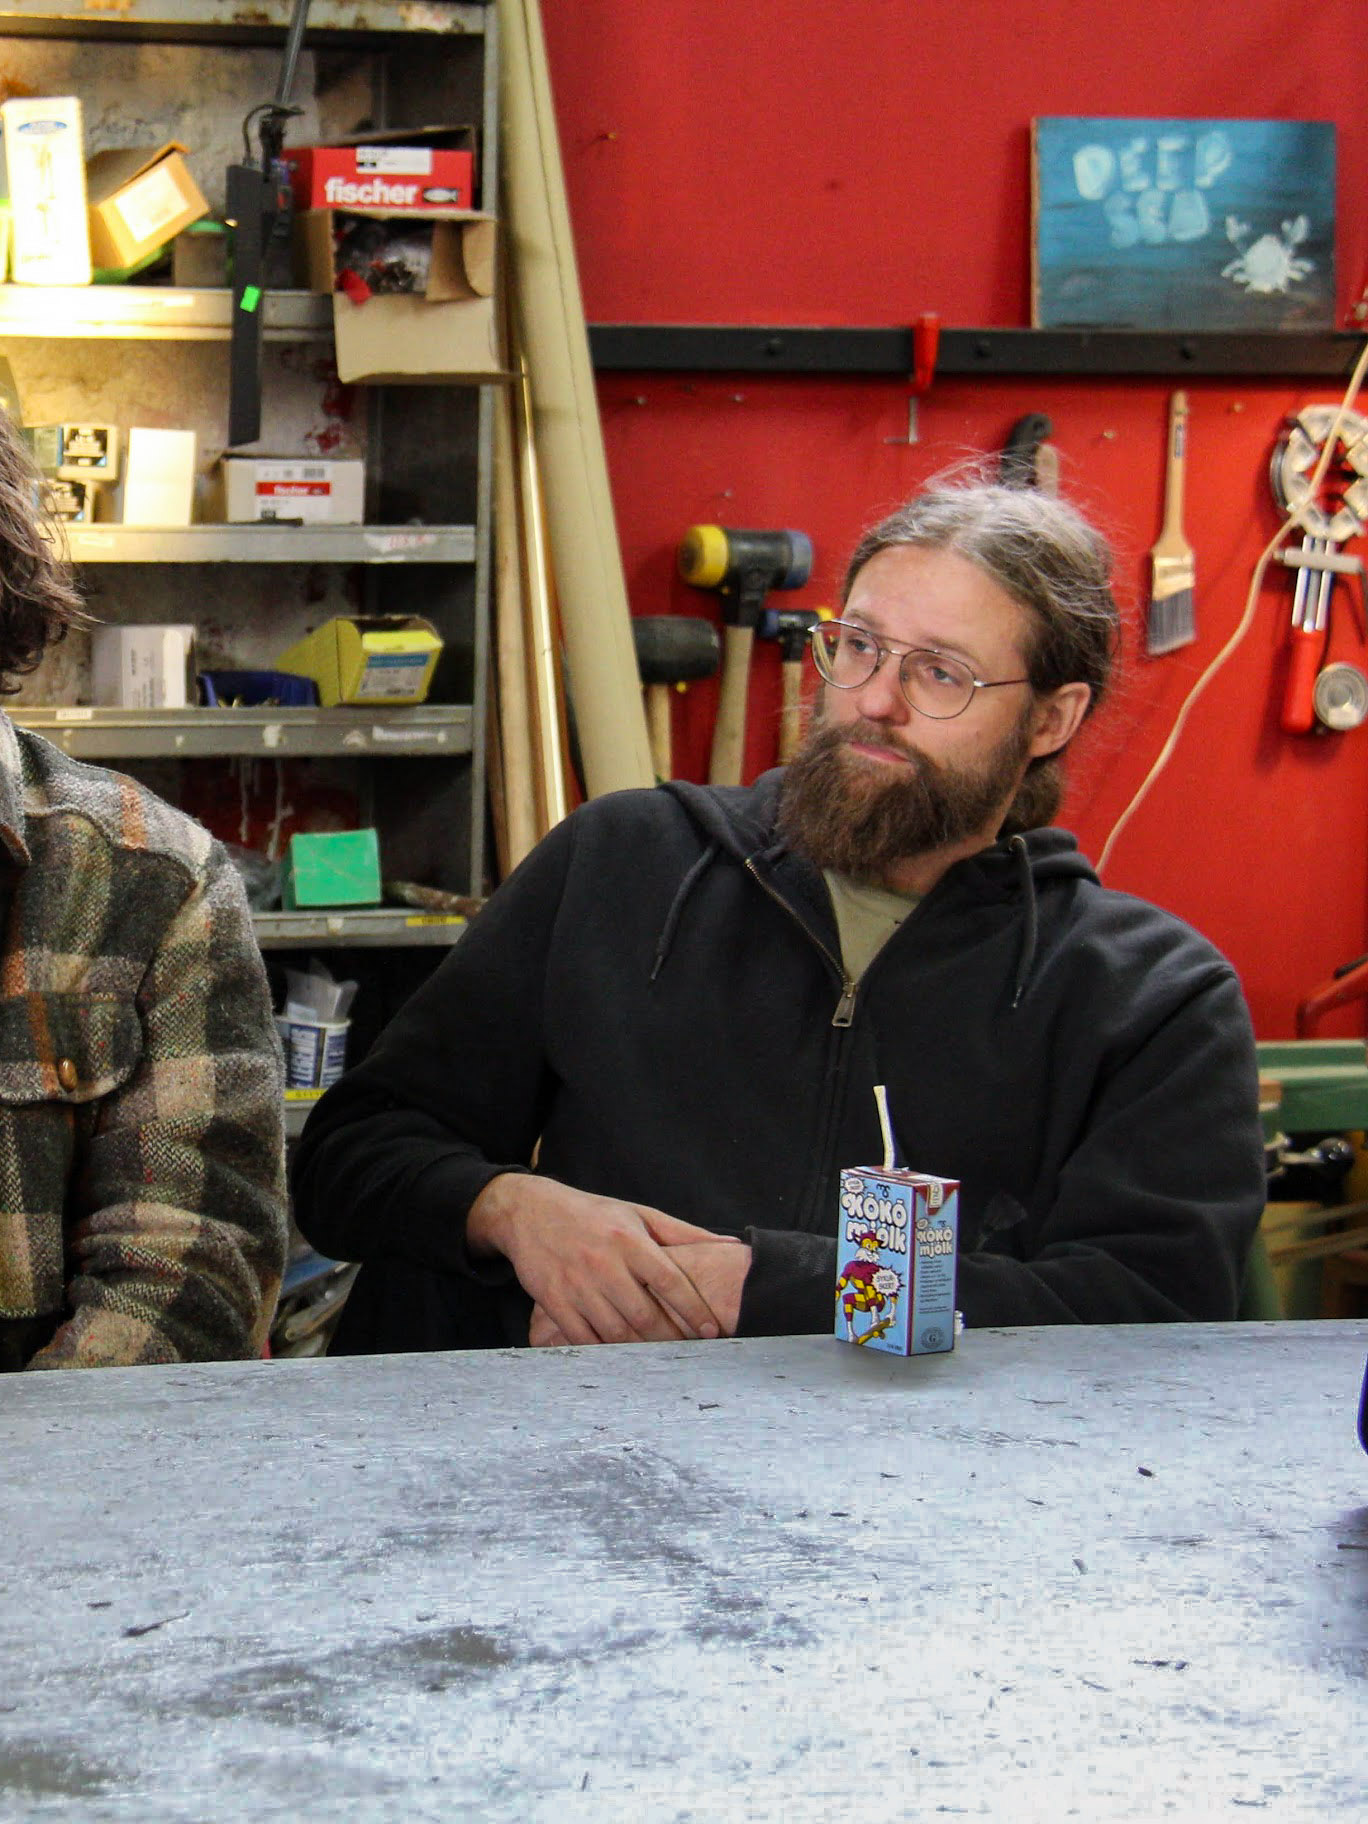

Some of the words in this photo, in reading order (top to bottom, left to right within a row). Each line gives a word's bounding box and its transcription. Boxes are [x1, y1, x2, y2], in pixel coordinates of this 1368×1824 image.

[324, 176, 419, 205] fischer
[1072, 130, 1233, 200] DEEP
[1103, 188, 1210, 249] SEA
